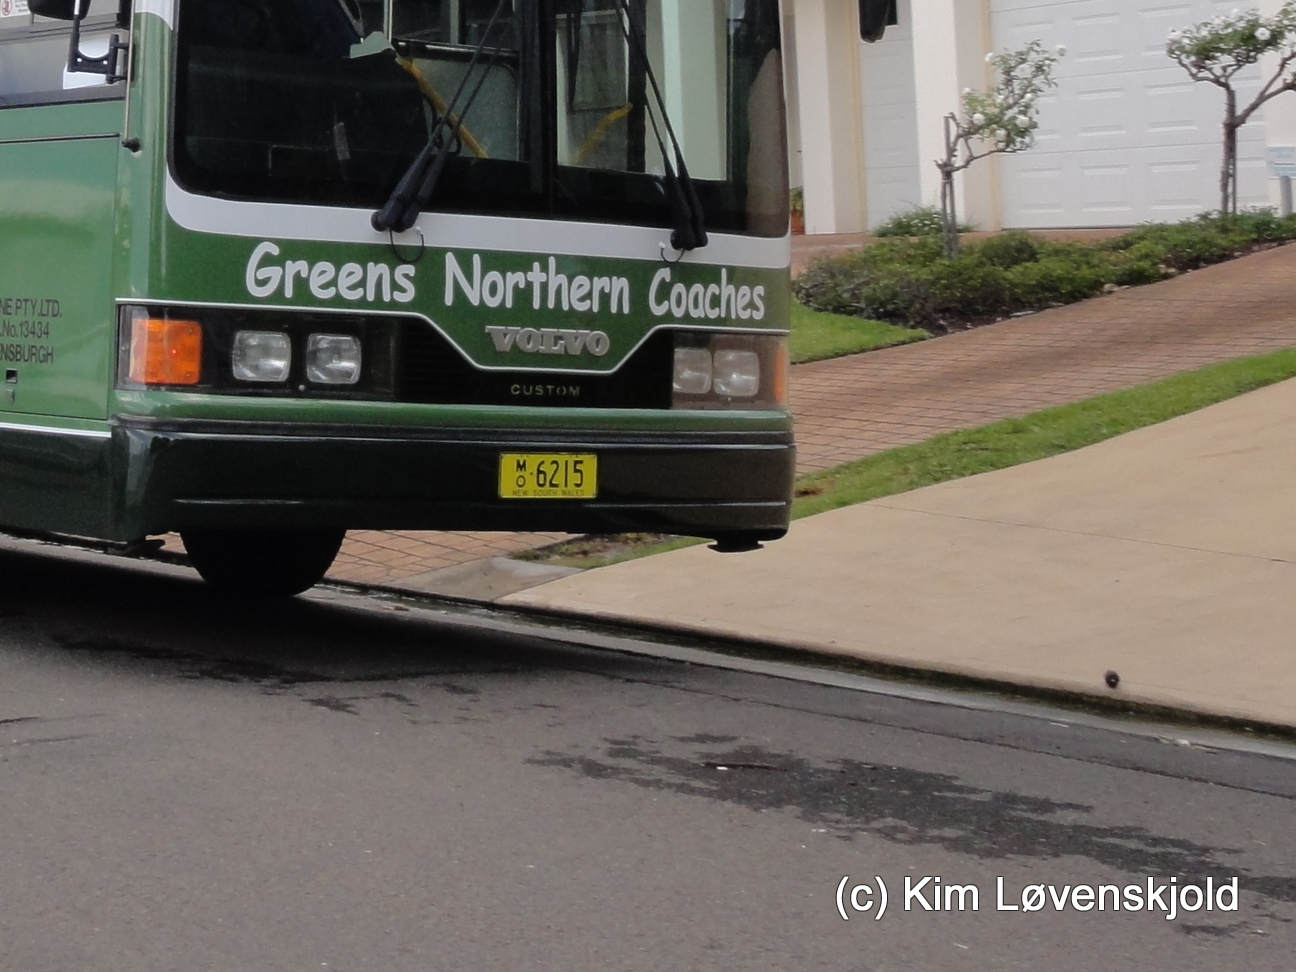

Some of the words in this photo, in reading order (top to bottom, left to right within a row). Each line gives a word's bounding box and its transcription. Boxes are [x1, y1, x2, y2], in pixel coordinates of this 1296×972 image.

[245, 241, 416, 303] Greens
[444, 251, 630, 315] Northern
[648, 267, 765, 321] Coaches
[485, 325, 610, 357] VOLVO
[510, 384, 581, 396] CUSTOM
[536, 459, 584, 488] 6215
